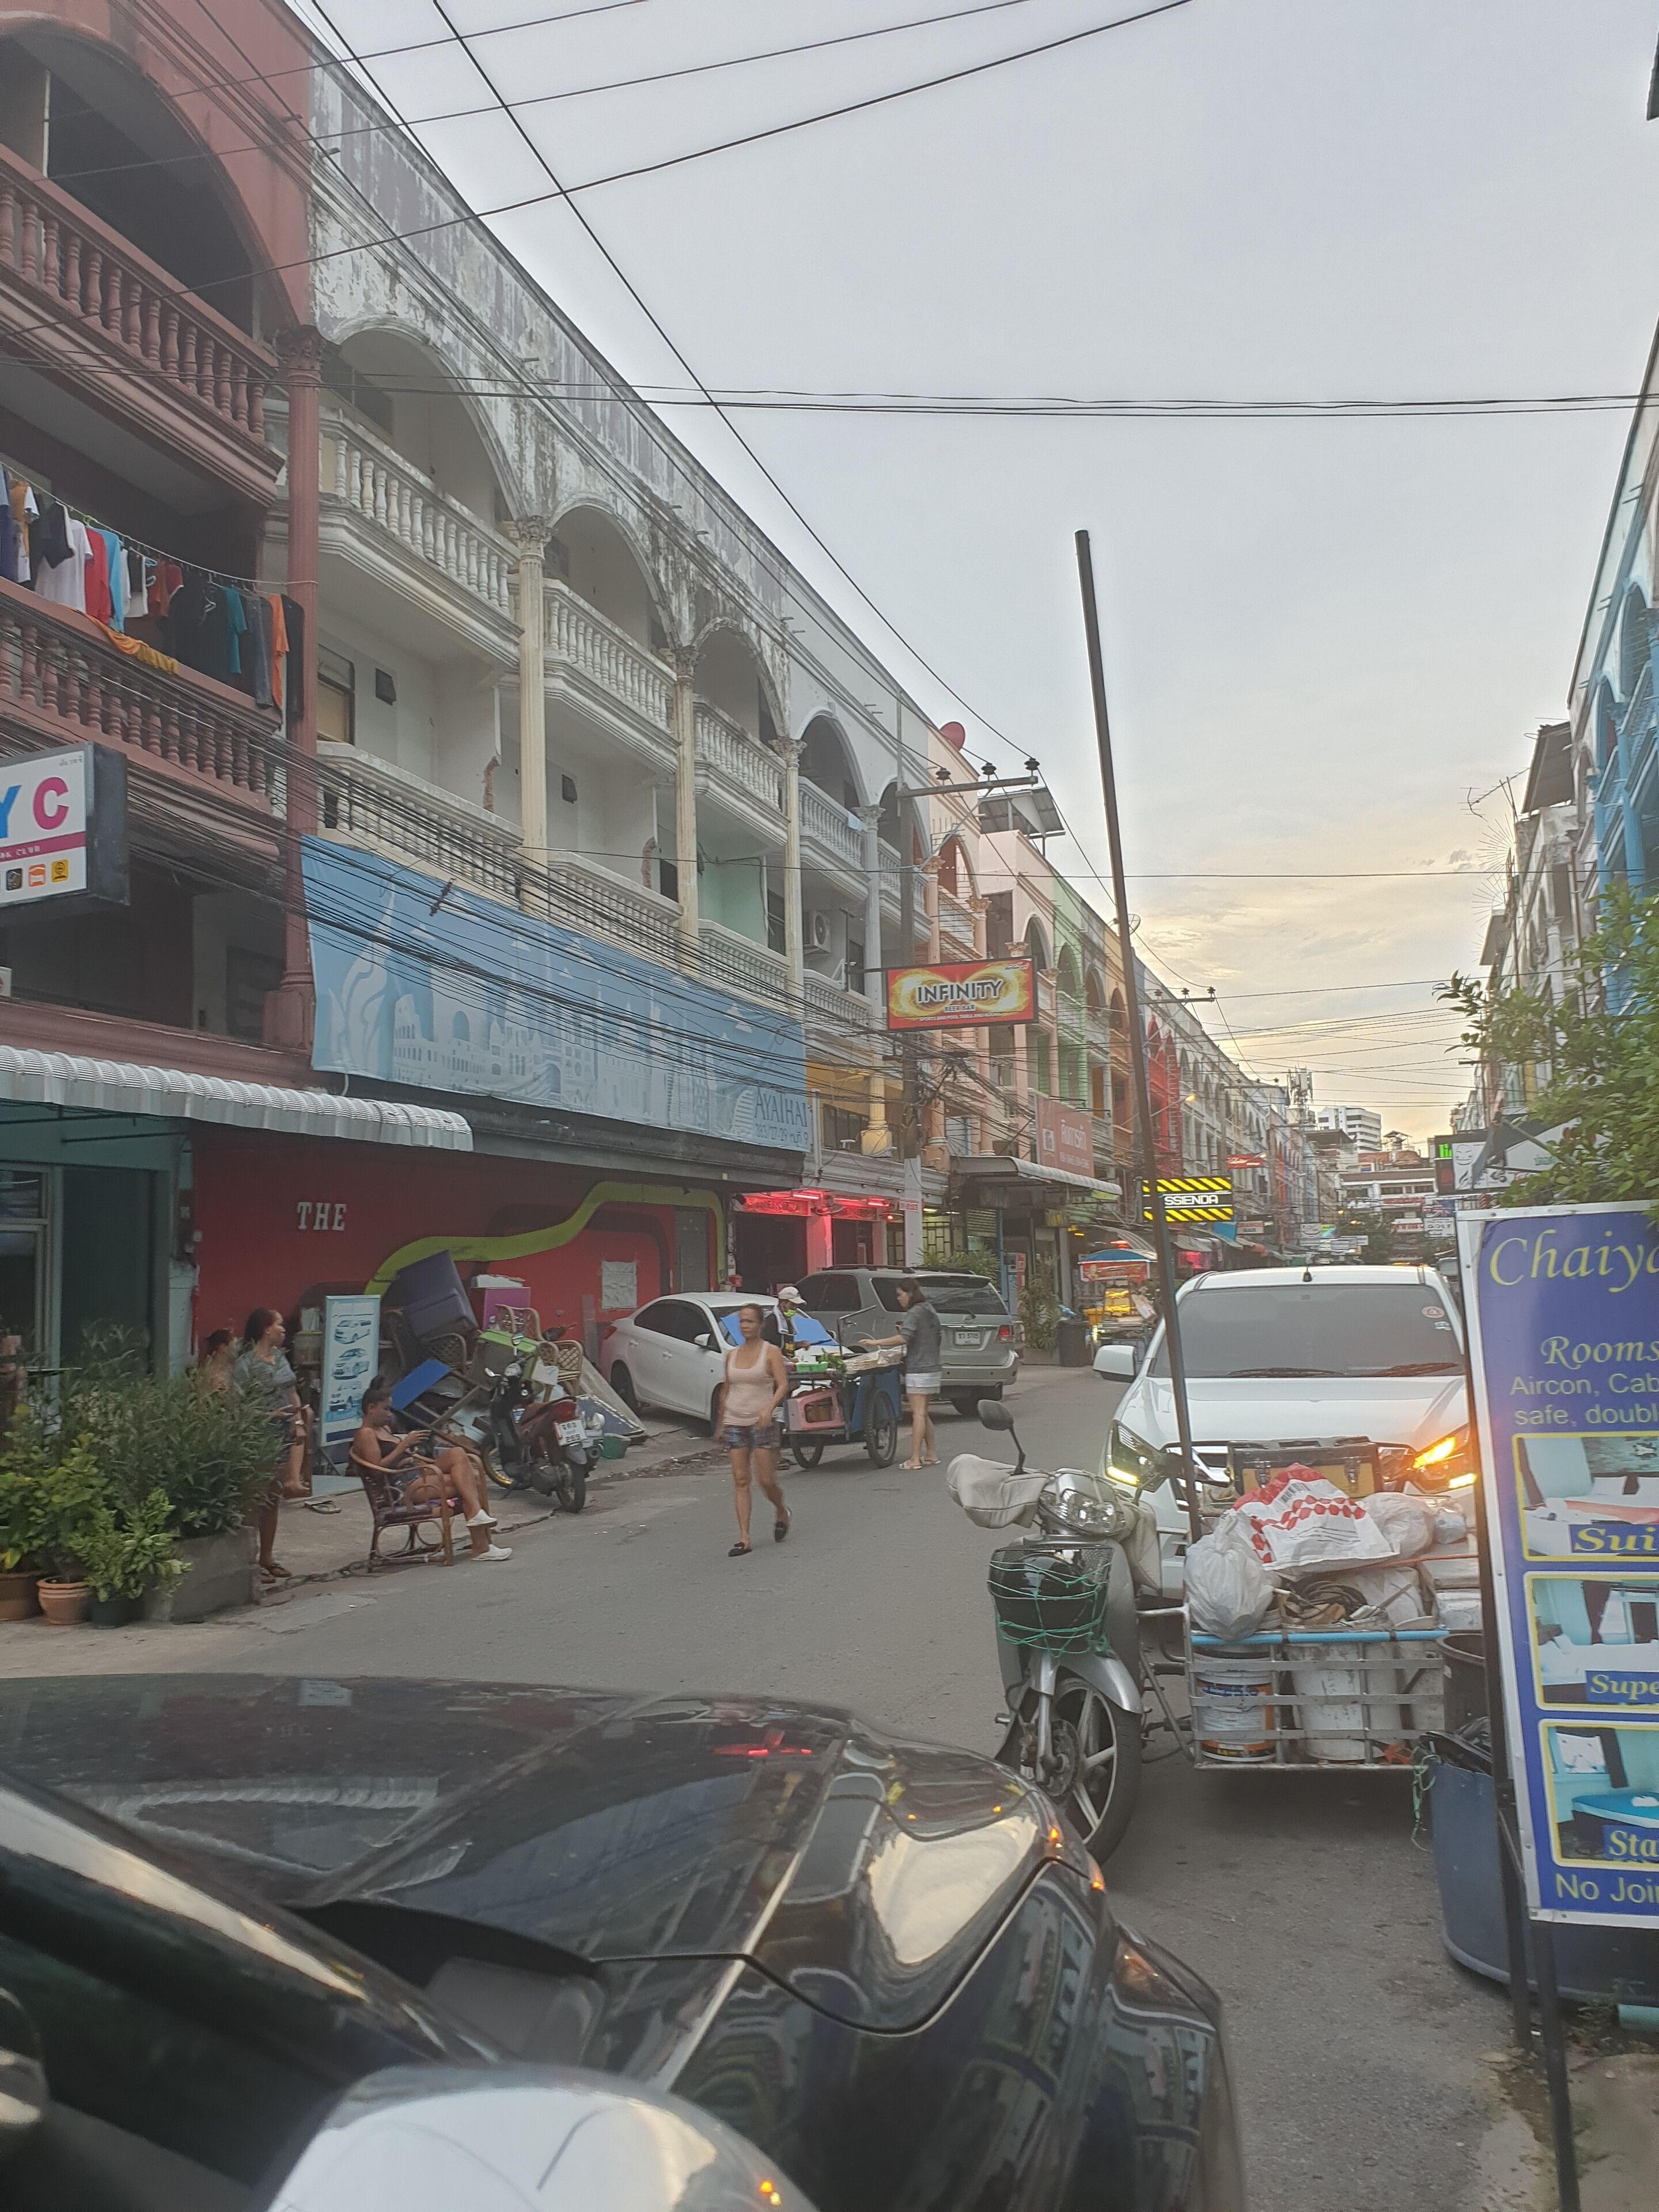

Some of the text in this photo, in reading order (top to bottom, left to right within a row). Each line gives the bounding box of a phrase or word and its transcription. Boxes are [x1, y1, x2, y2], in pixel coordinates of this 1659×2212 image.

[16, 846, 40, 856] CLUB
[917, 979, 1003, 1003] INFINITY
[296, 1202, 347, 1231] THE
[1540, 1336, 1659, 1370] Rooms
[1510, 1372, 1659, 1397] Aircon, Cab
[1514, 1404, 1577, 1427] safe,
[1574, 1527, 1658, 1551] Sui
[1590, 1674, 1659, 1700] Supe
[1556, 1873, 1600, 1900] No
